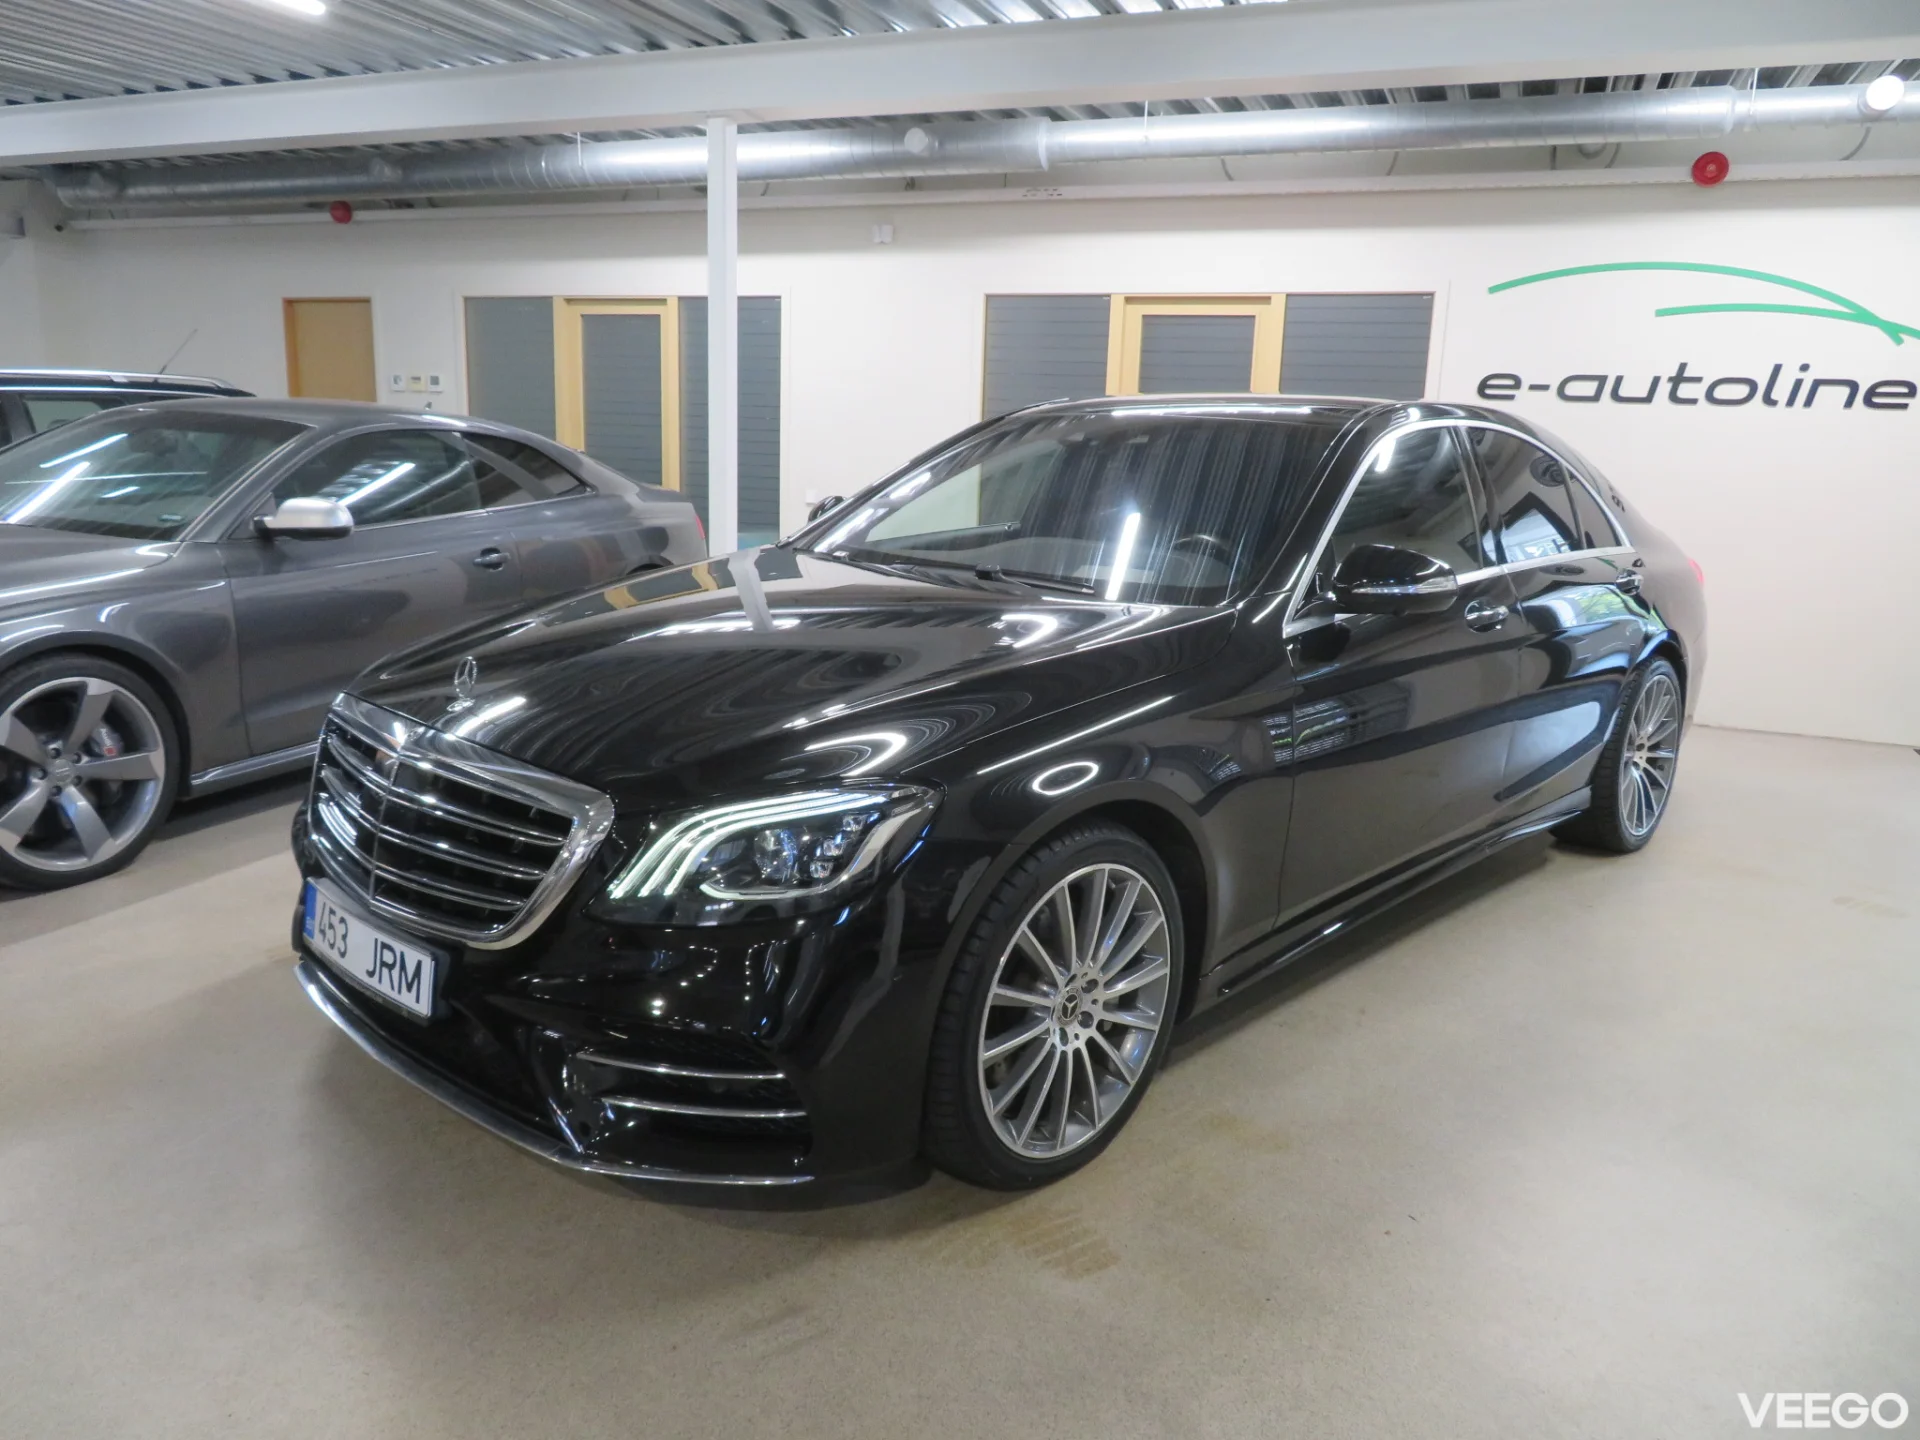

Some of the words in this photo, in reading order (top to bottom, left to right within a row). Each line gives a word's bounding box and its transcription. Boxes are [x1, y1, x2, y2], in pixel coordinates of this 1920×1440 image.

[1477, 362, 1918, 410] e-autoline
[318, 901, 348, 958] 453
[366, 938, 422, 1004] JRM
